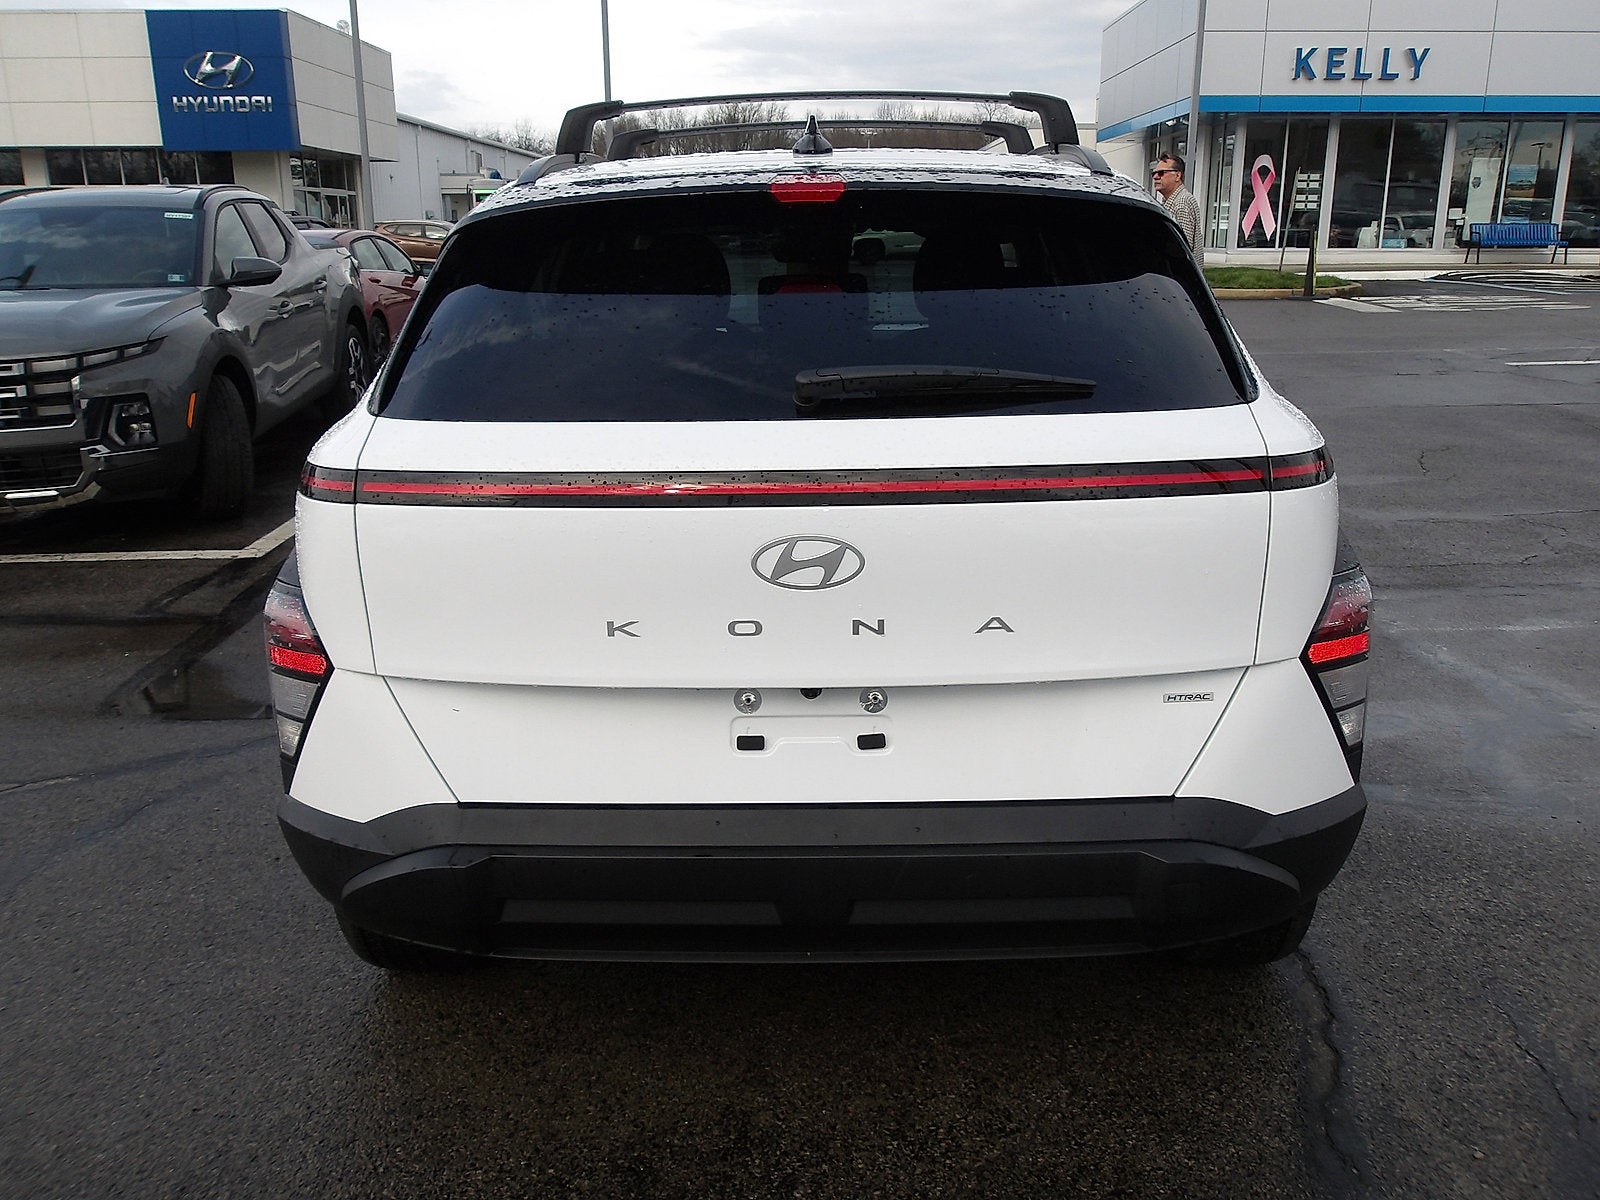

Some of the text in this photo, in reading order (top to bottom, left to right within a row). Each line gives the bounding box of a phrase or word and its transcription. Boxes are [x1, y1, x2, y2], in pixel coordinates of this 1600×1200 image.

[1292, 47, 1431, 80] KELLY
[171, 95, 274, 113] HYUNDAI
[606, 616, 1016, 638] KONA
[1166, 693, 1211, 702] HTRAC
